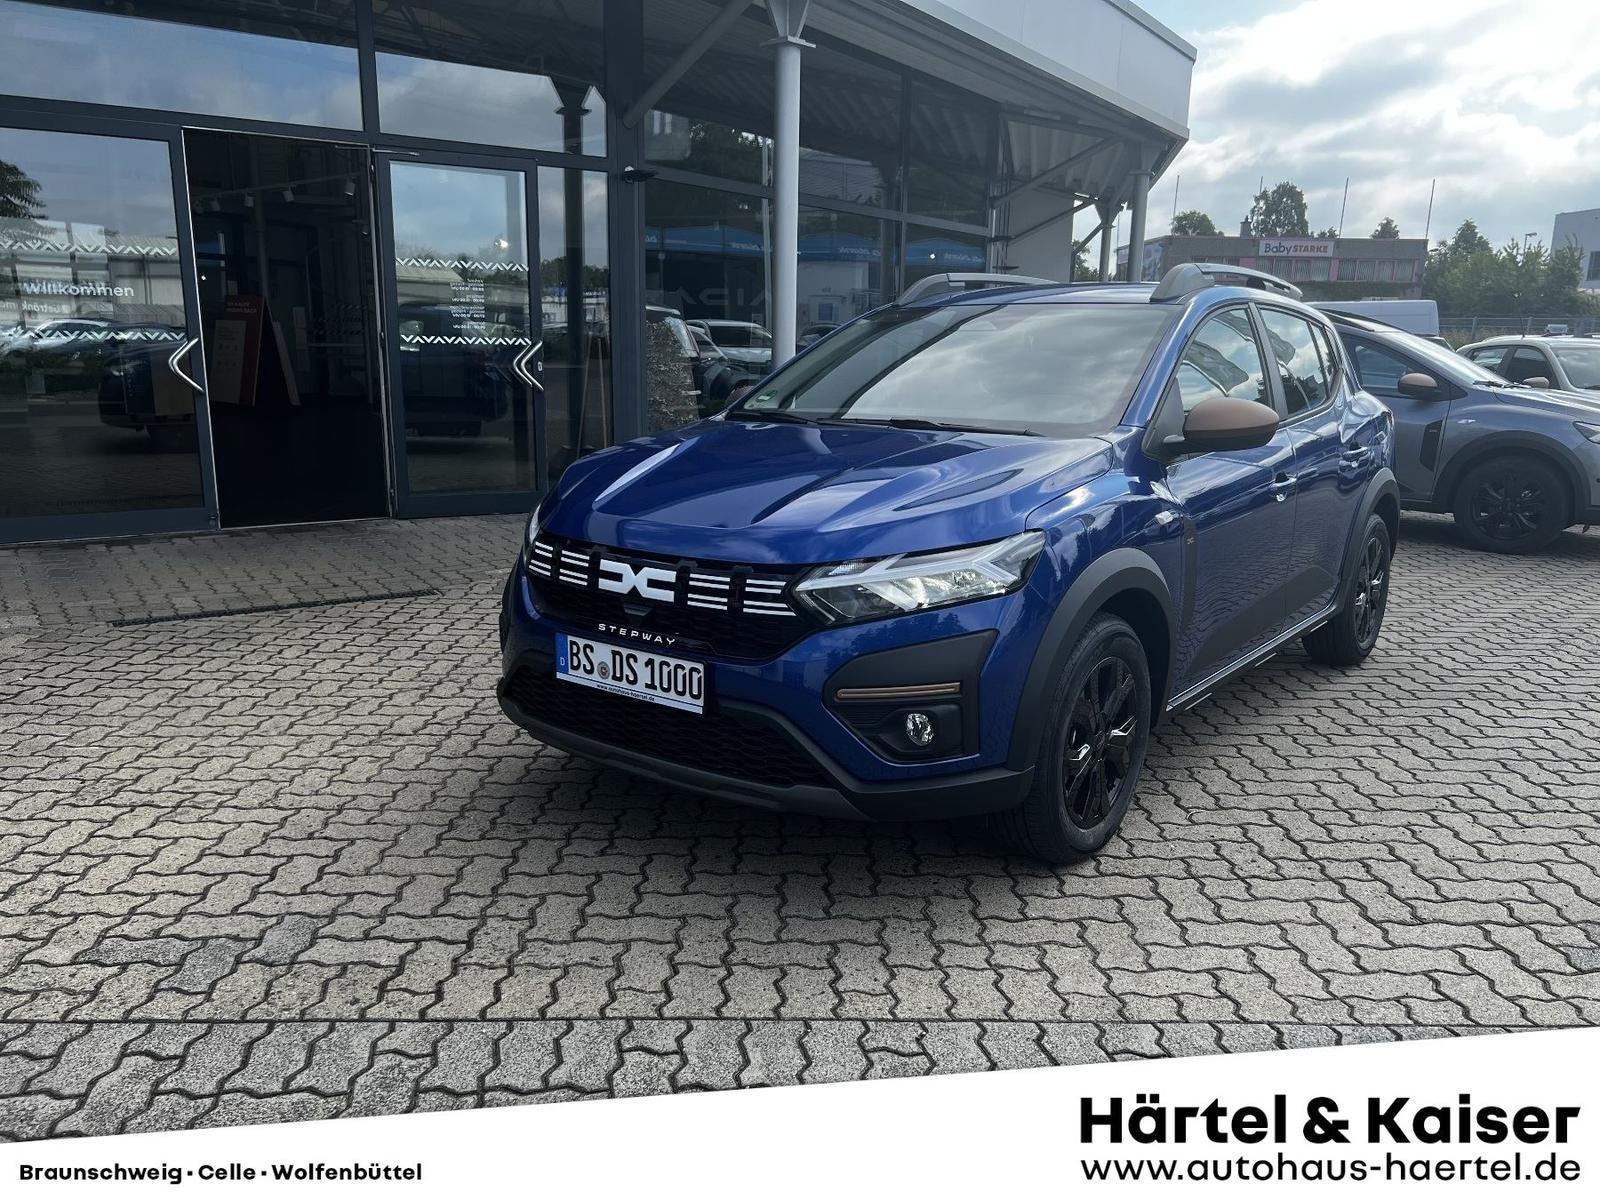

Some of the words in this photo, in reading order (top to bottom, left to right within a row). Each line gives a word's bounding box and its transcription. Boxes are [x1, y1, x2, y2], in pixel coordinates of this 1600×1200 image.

[23, 280, 135, 297] Willkommen
[597, 623, 676, 646] STEPWAY
[569, 639, 595, 675] BS
[611, 649, 638, 686] DS
[644, 658, 702, 700] 1000
